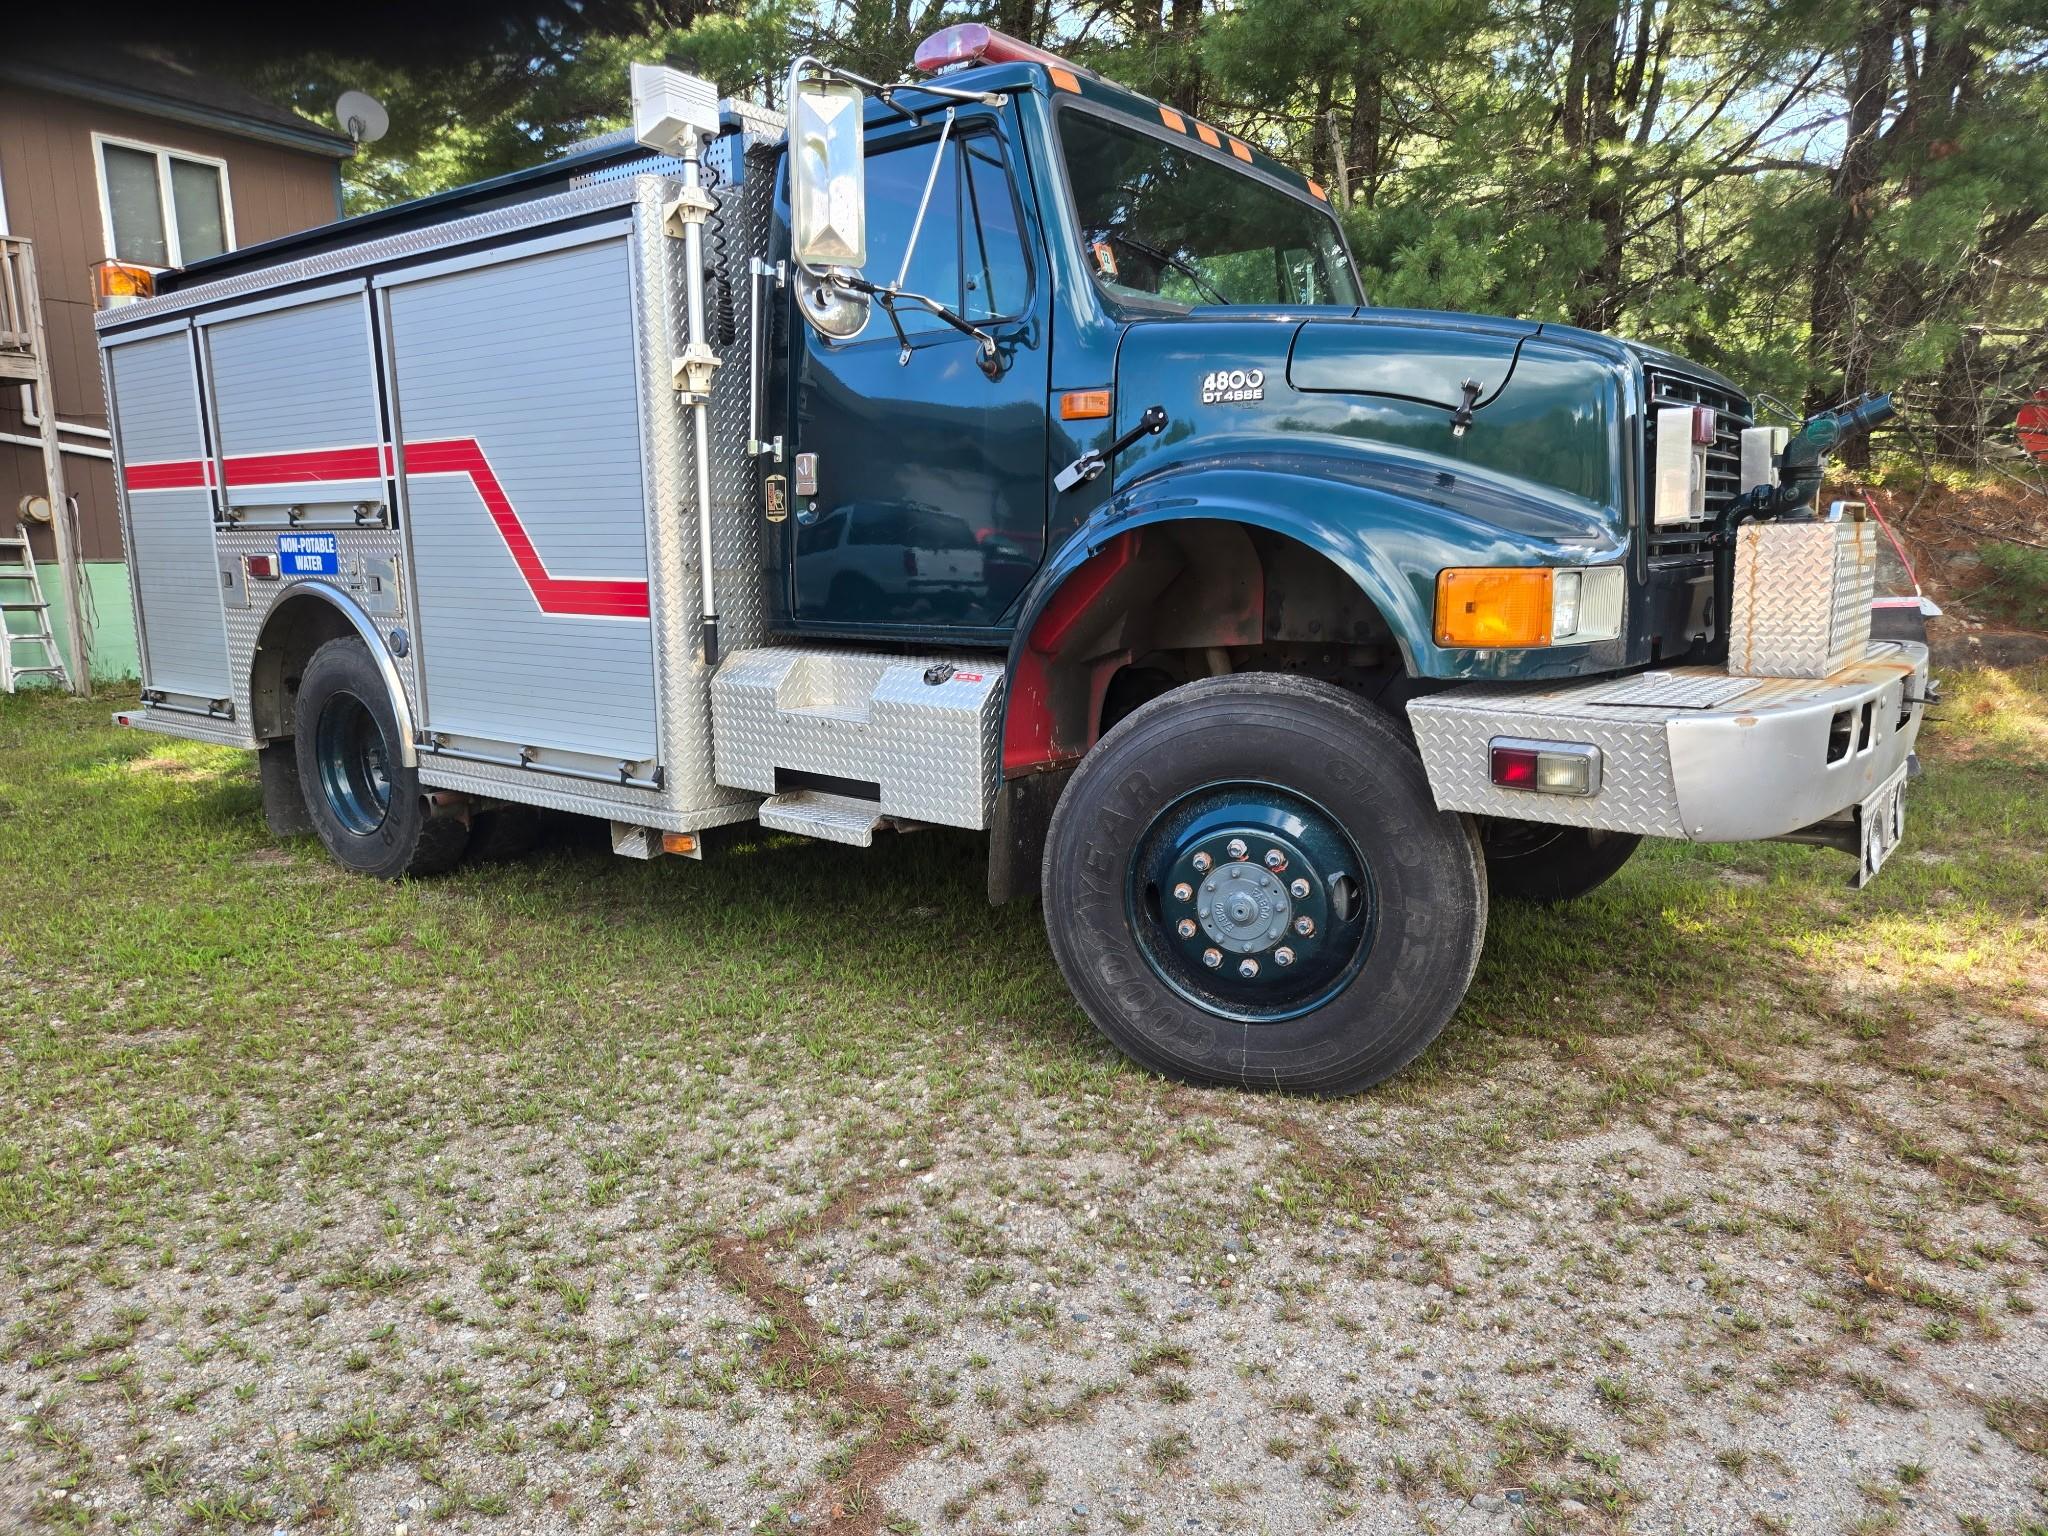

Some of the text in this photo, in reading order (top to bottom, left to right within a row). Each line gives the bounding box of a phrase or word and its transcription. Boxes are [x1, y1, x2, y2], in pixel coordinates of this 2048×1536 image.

[1203, 369, 1265, 391] 4800
[280, 537, 335, 553] NON-POTABLE
[295, 555, 323, 571] WATER
[1075, 769, 1217, 1057] GOODYEAR
